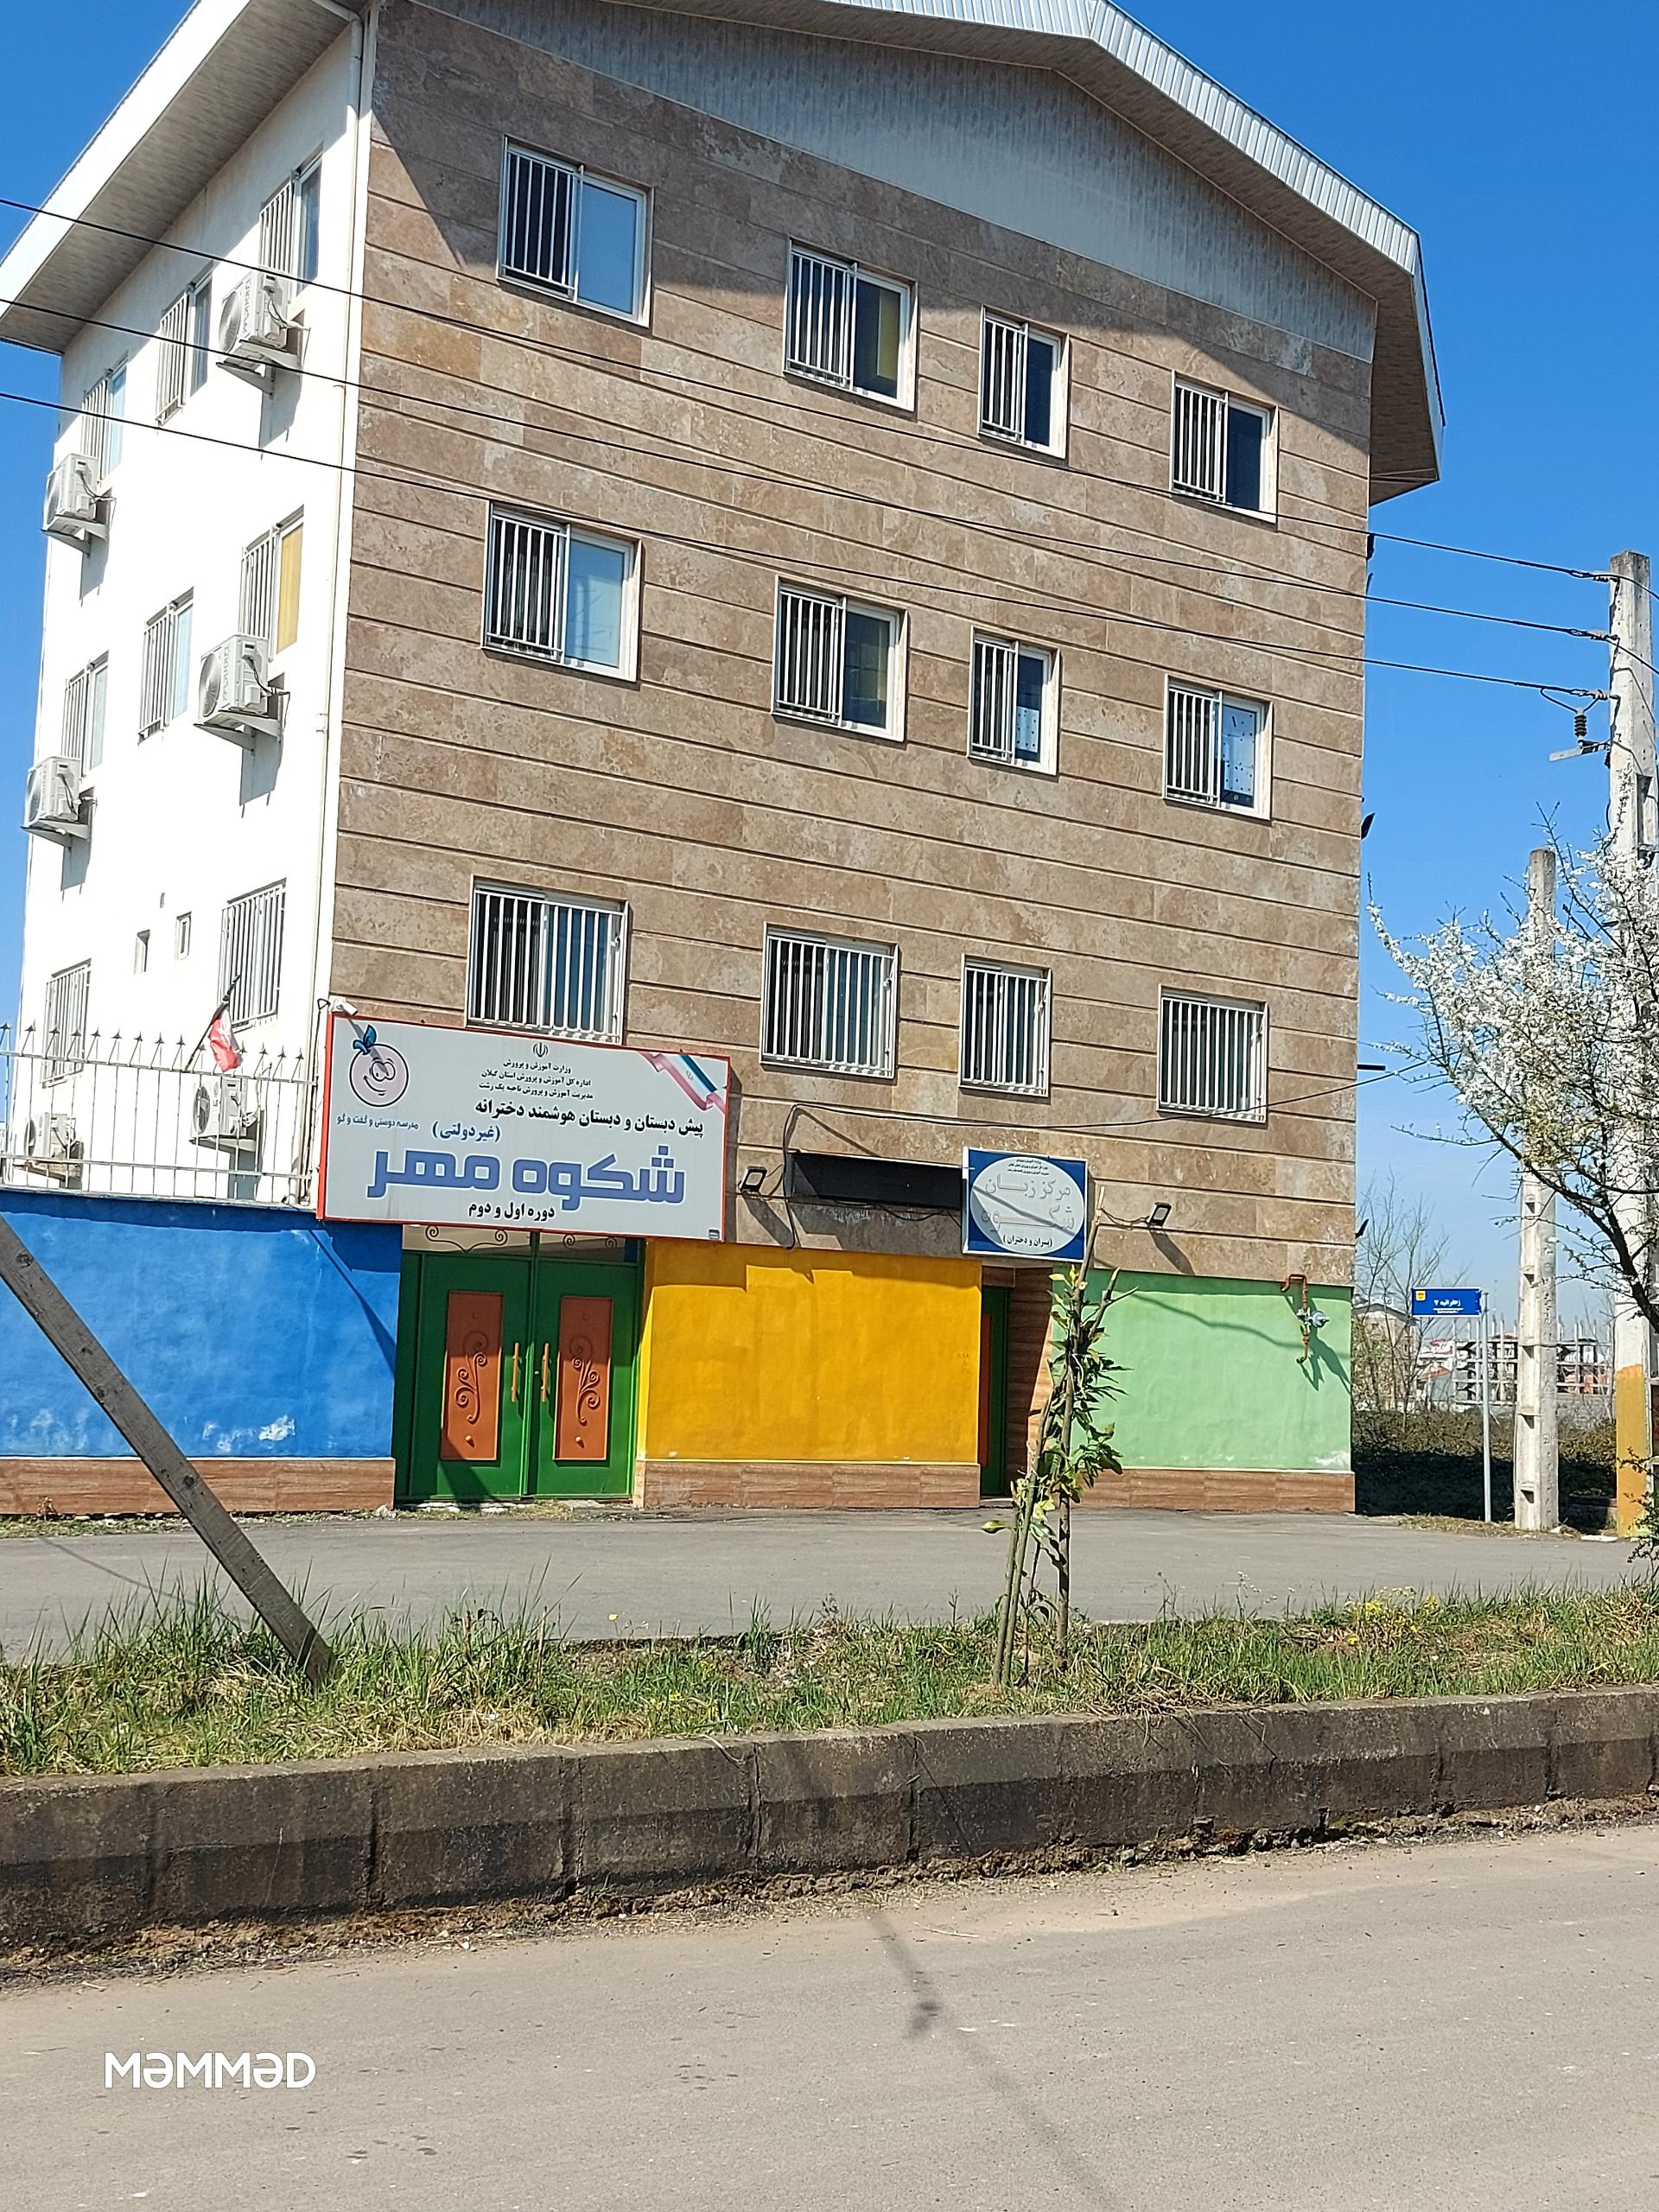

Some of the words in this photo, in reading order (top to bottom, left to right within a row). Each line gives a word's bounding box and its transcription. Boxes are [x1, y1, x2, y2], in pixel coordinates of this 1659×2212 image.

[503, 1058, 524, 1069] پرورش
[530, 1062, 551, 1071] آموزش
[553, 1065, 571, 1073] وزارت
[499, 1071, 516, 1079] استان
[517, 1072, 537, 1083] پرورش
[543, 1077, 565, 1085] آموزش
[479, 1082, 493, 1090] رشت
[494, 1083, 505, 1091] یک
[522, 1086, 543, 1096] پرورش
[549, 1090, 570, 1098] آموزش
[475, 1099, 524, 1119] دخترانه
[528, 1105, 576, 1125] هوشمند
[374, 1118, 395, 1128] دوستی
[578, 1109, 620, 1128] دبستان
[634, 1114, 676, 1132] دبستان
[397, 1121, 419, 1130] مدرسه
[623, 1119, 632, 1131] و
[678, 1118, 704, 1138] پیش
[367, 1147, 501, 1198] مهر
[512, 1145, 685, 1211] شکوه
[985, 1173, 1036, 1198] زبان
[1039, 1179, 1071, 1201] مرکز
[468, 1201, 492, 1217] دوم
[494, 1206, 501, 1218] و
[504, 1203, 524, 1220] اول
[528, 1206, 555, 1221] دوره
